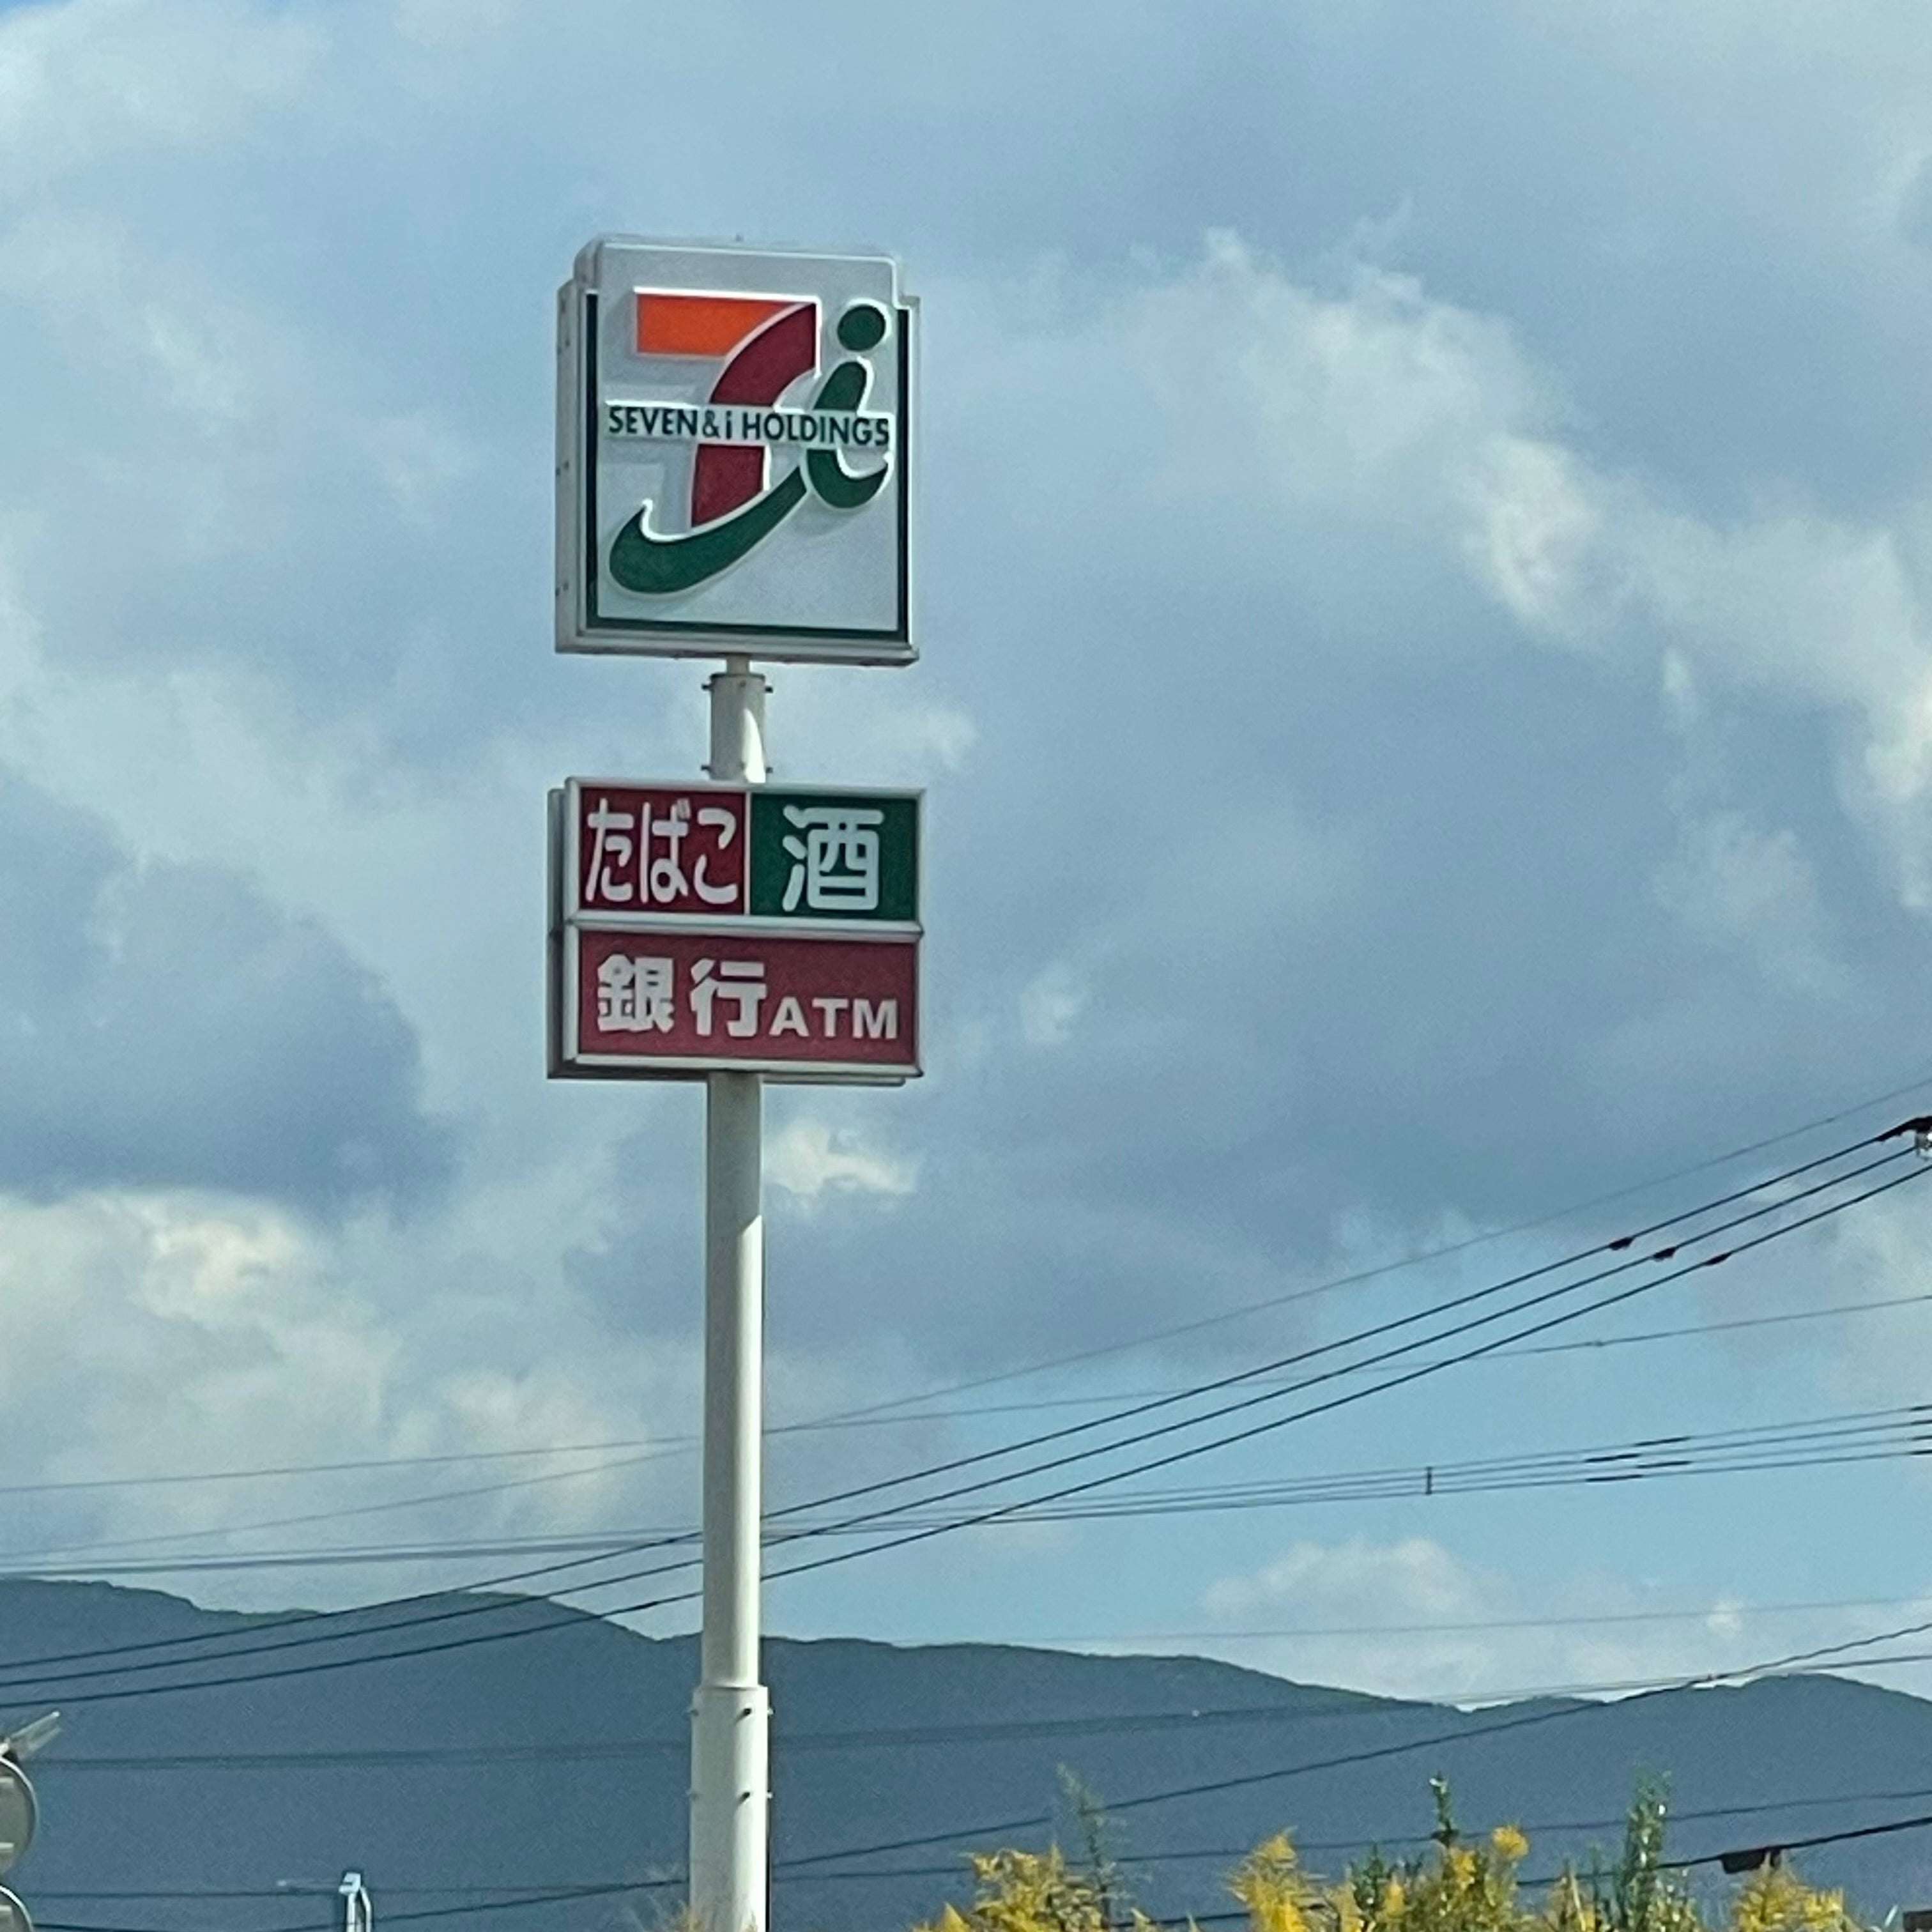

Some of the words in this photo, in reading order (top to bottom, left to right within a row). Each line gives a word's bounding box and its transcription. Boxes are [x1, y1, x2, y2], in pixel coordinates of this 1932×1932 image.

[742, 414, 890, 447] HOLDINGS
[586, 797, 739, 905] たばこ
[781, 804, 885, 912] 酒
